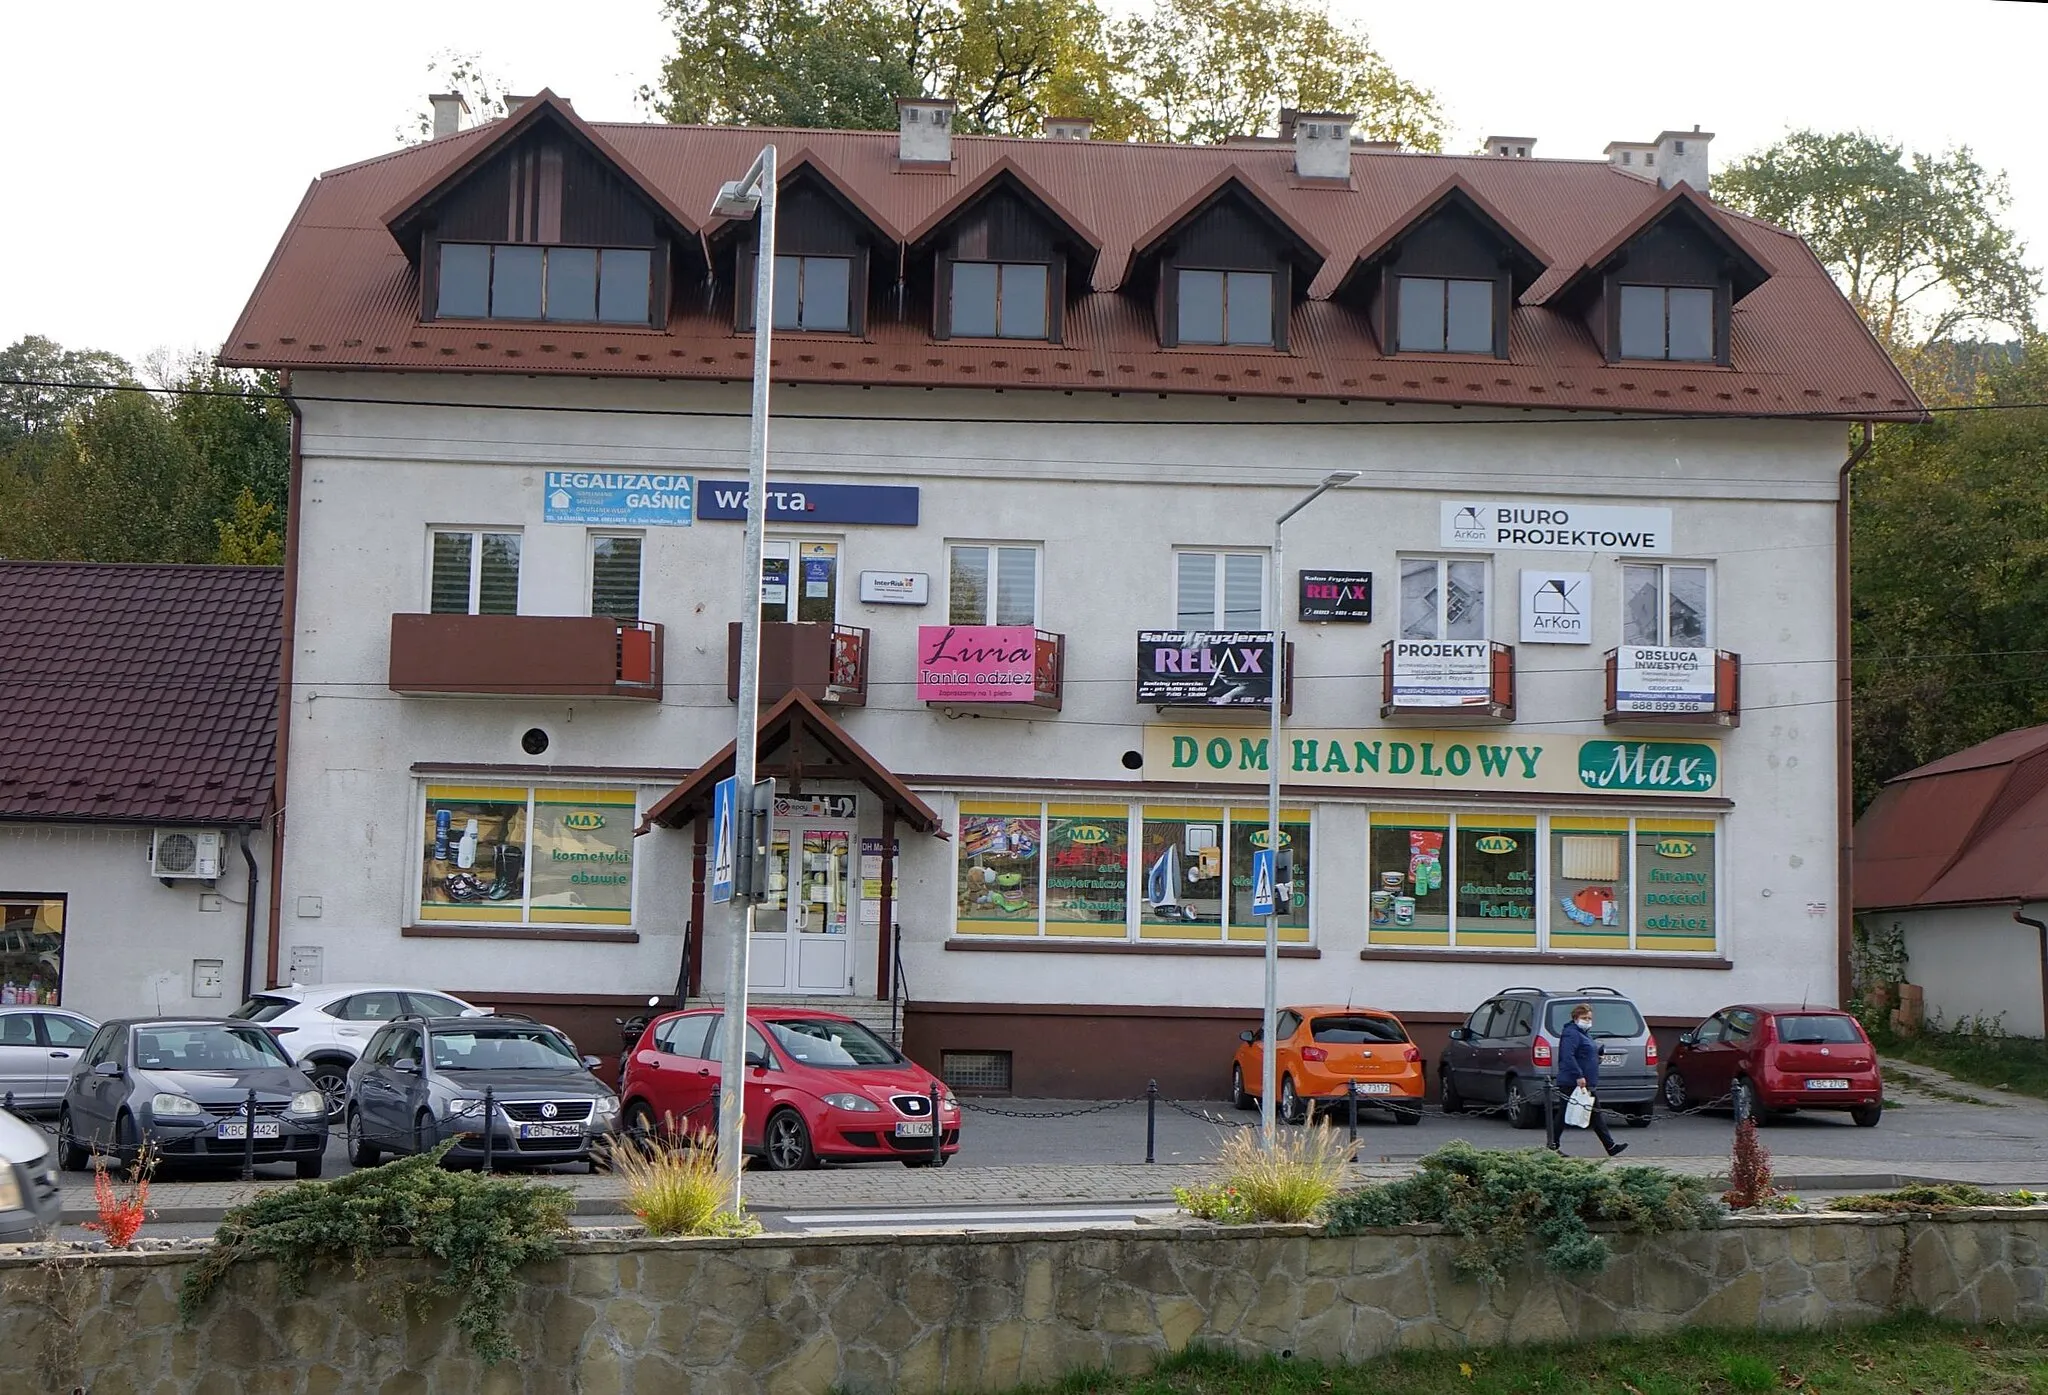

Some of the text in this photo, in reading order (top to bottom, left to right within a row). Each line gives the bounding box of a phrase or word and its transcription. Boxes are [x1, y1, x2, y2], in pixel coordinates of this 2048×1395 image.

[549, 472, 690, 491] LEGALIZACJA
[626, 491, 691, 509] GAŚNIC
[1497, 508, 1569, 525] BIURO
[1454, 528, 1656, 548] ArKon PROJEKTOWE
[874, 579, 904, 587] InterRisk
[1328, 575, 1369, 583] Fryzjerski
[1306, 585, 1366, 607] RELAX
[1533, 615, 1581, 630] ArKon
[1140, 632, 1186, 643] Salon
[924, 627, 1032, 665] Livia
[1398, 644, 1487, 658] PROJEKTY
[1635, 650, 1698, 662] OBSŁUGA
[1155, 647, 1264, 686] RELAX
[1635, 661, 1699, 671] INWESTYCJI
[921, 670, 1033, 685] Tania odzież
[1632, 701, 1700, 711] 888 899 366
[1172, 735, 1270, 771] DOM
[1291, 739, 1544, 779] HANDLOWY
[565, 814, 604, 826] MAX
[1069, 828, 1109, 840] MAX
[862, 842, 872, 851] DH
[1477, 838, 1516, 850] MAX
[1657, 843, 1695, 854] MAX
[552, 848, 630, 865] kosmetyki
[570, 871, 627, 885] obuwie
[1047, 876, 1126, 889] papiernicze
[1507, 870, 1534, 881] art.
[1649, 867, 1708, 886] firany
[1460, 882, 1534, 896] chemiczne
[1062, 896, 1124, 911] zabawki
[1646, 889, 1707, 906] pościel
[1480, 900, 1531, 920] Farby
[1646, 913, 1708, 930] odzież
[225, 1125, 278, 1136] KBC 4424
